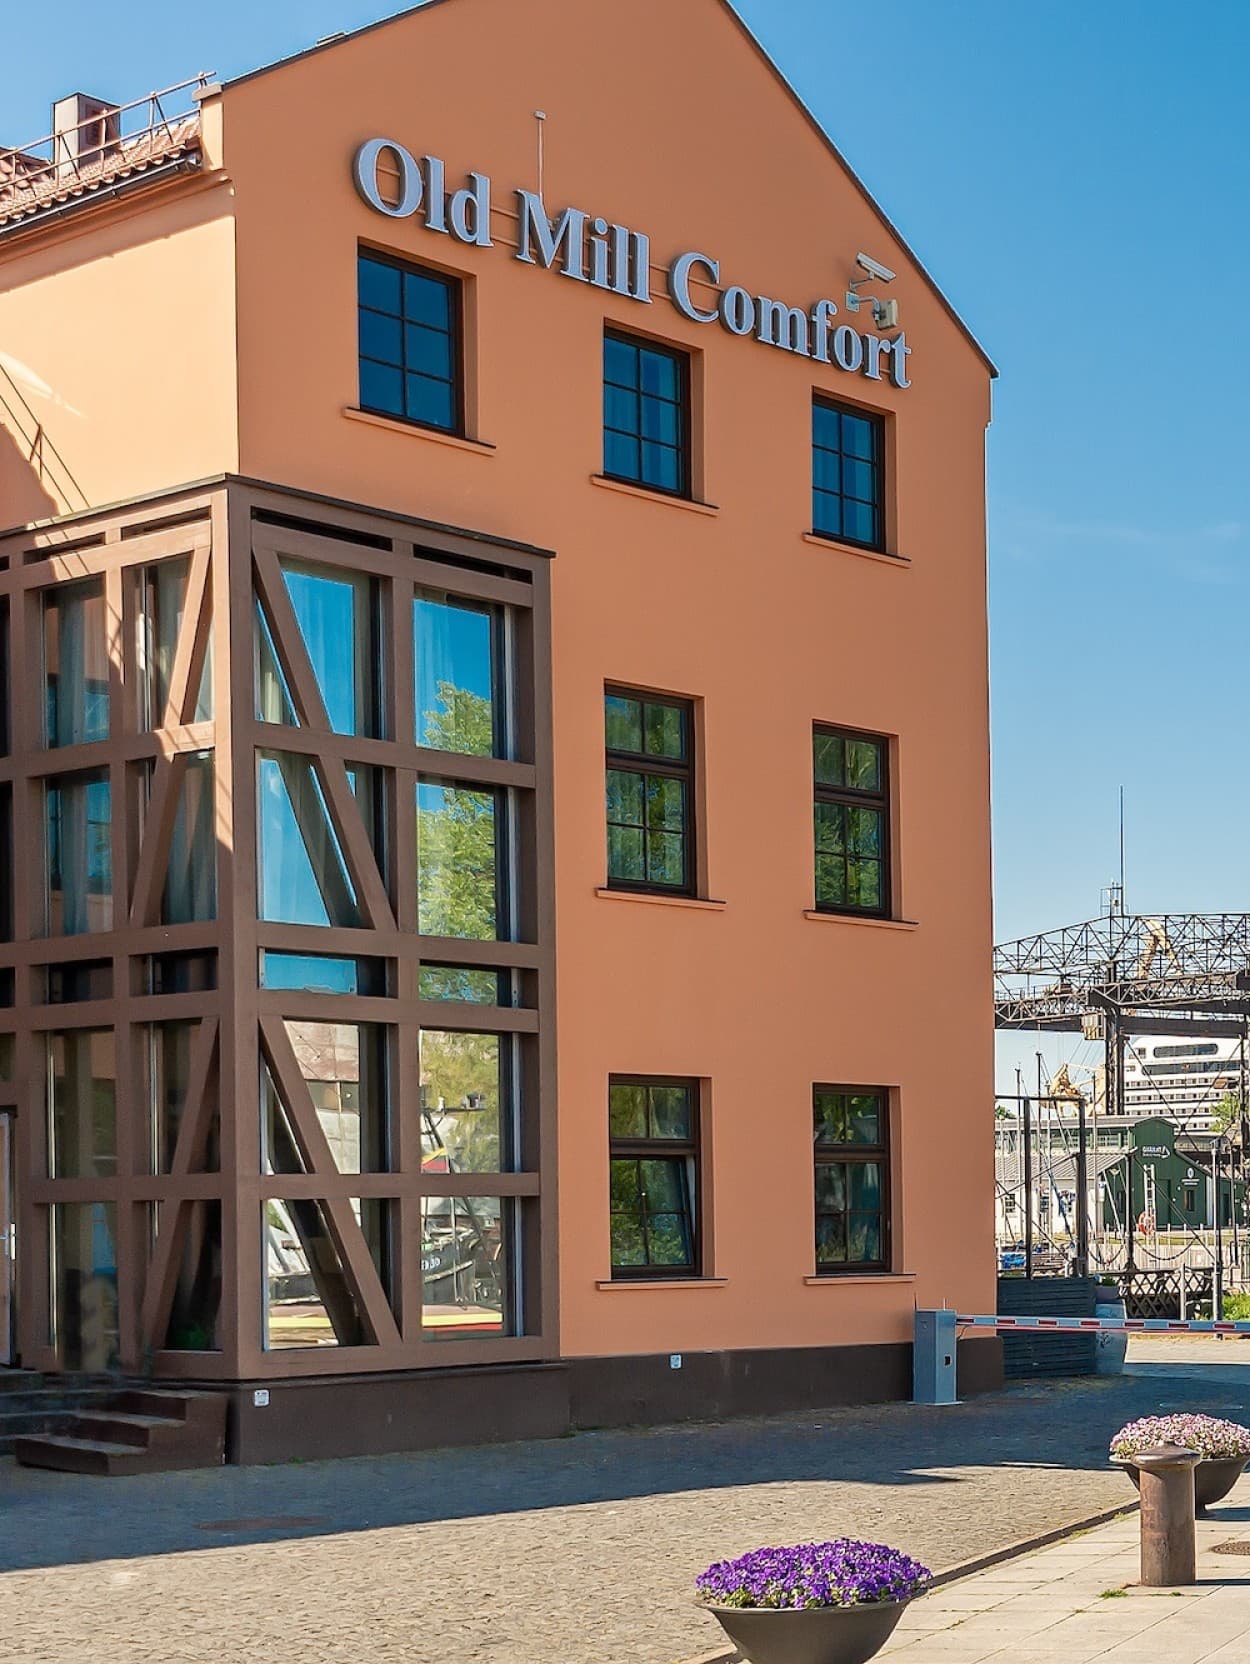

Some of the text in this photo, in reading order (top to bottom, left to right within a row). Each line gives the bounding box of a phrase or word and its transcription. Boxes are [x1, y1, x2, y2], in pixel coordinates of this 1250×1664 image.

[354, 137, 913, 389] Old Mill Comfort
